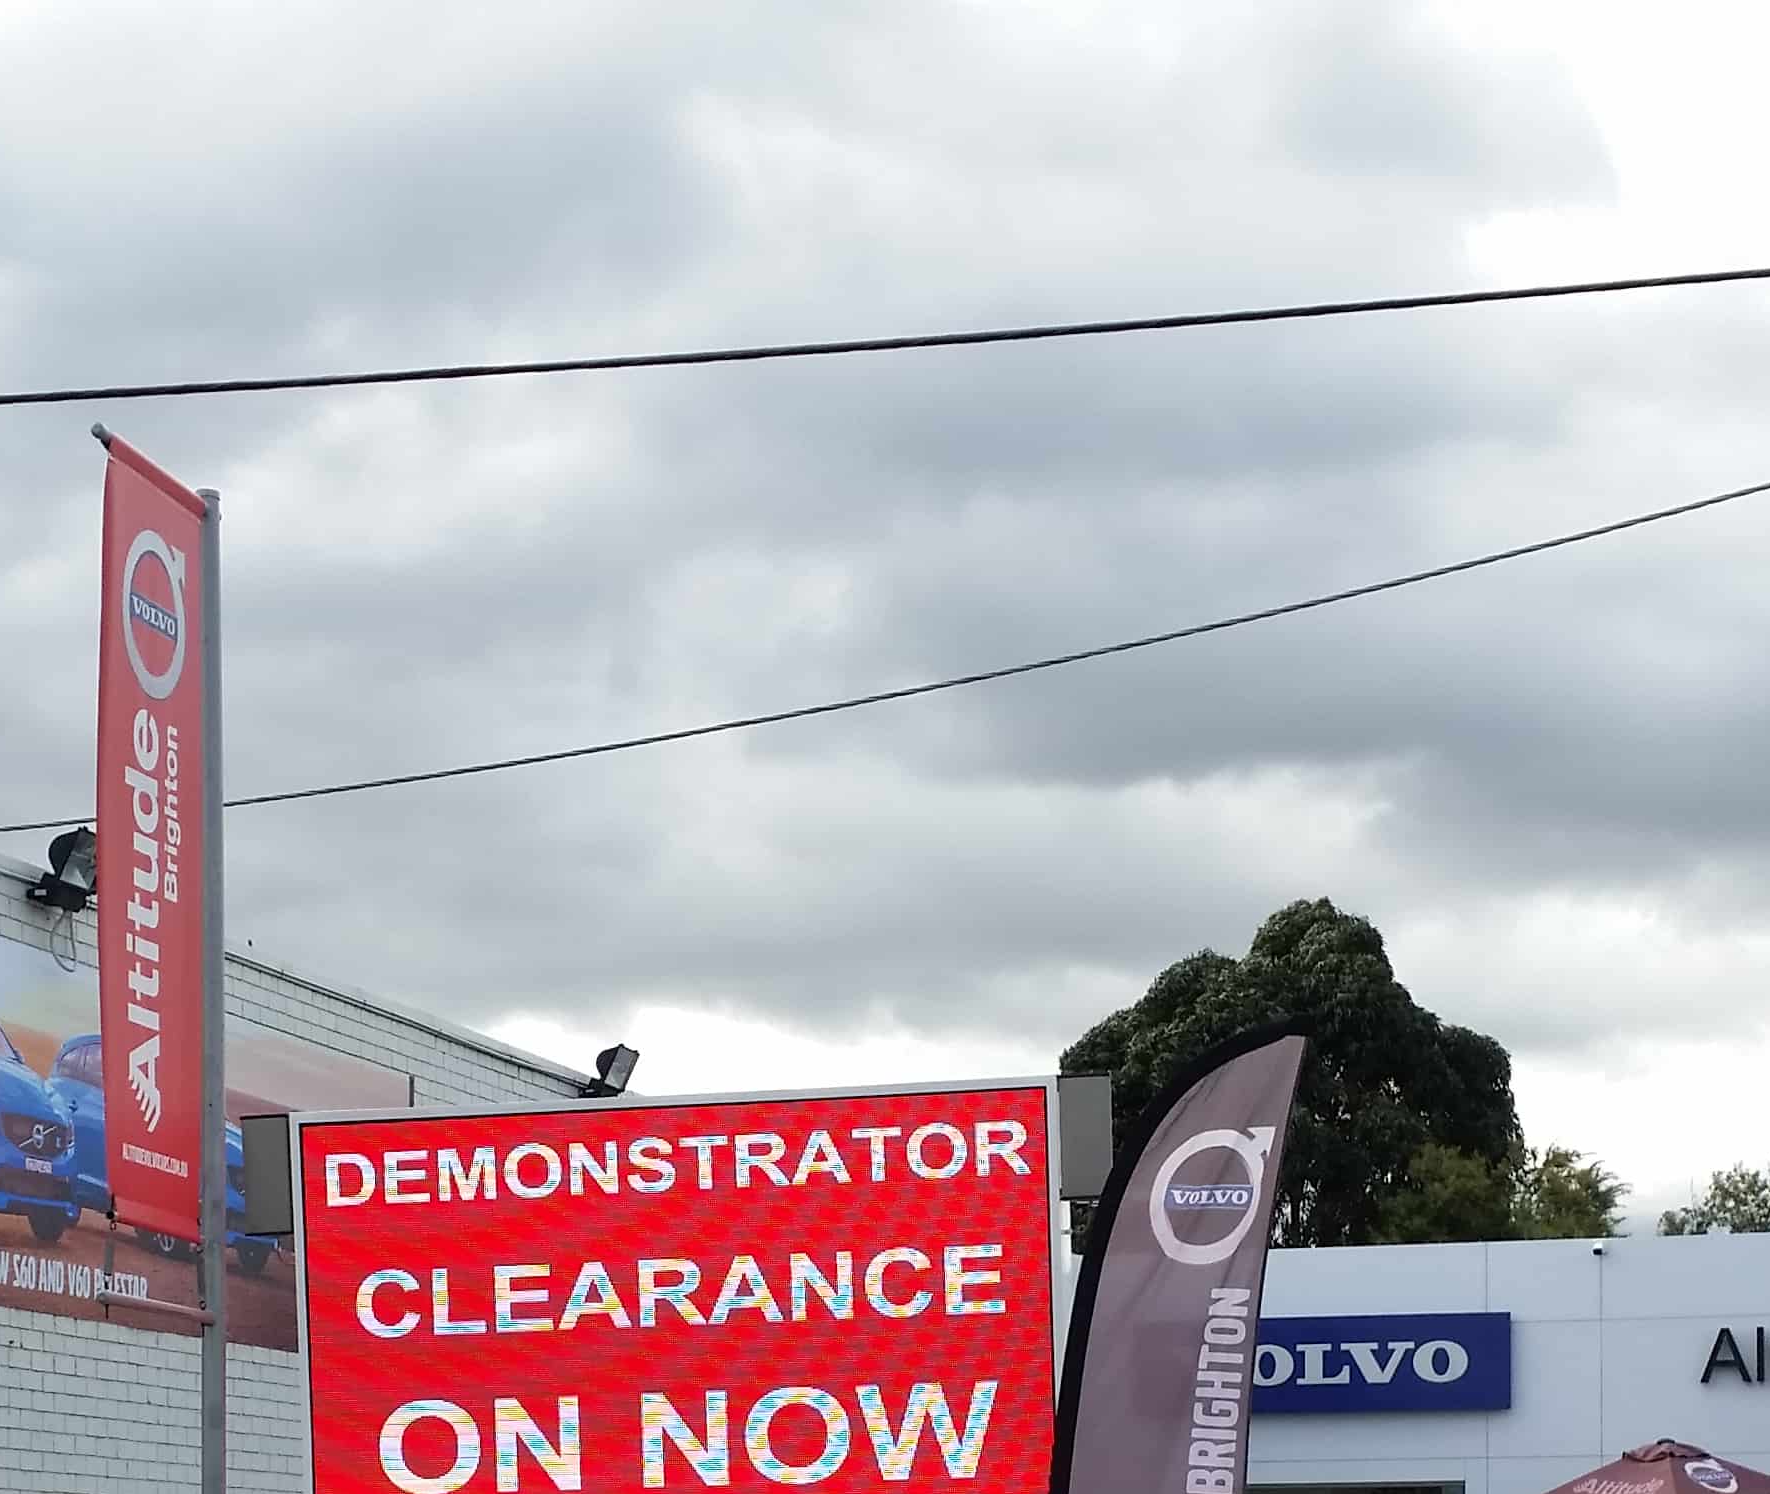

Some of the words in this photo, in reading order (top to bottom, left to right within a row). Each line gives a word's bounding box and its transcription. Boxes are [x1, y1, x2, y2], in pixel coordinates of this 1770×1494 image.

[131, 595, 177, 637] VOLVO
[164, 725, 182, 903] Brighton
[125, 708, 161, 1134] Altitude
[326, 1119, 1031, 1208] DEMONSTRATOR
[1171, 1188, 1249, 1206] VOLVO
[13, 1253, 36, 1291] S60
[38, 1258, 65, 1294] AND
[68, 1264, 91, 1299] V60
[355, 1243, 1008, 1339] CLEARANCE
[1252, 1340, 1470, 1387] OLVO
[640, 1379, 1000, 1488] NOW
